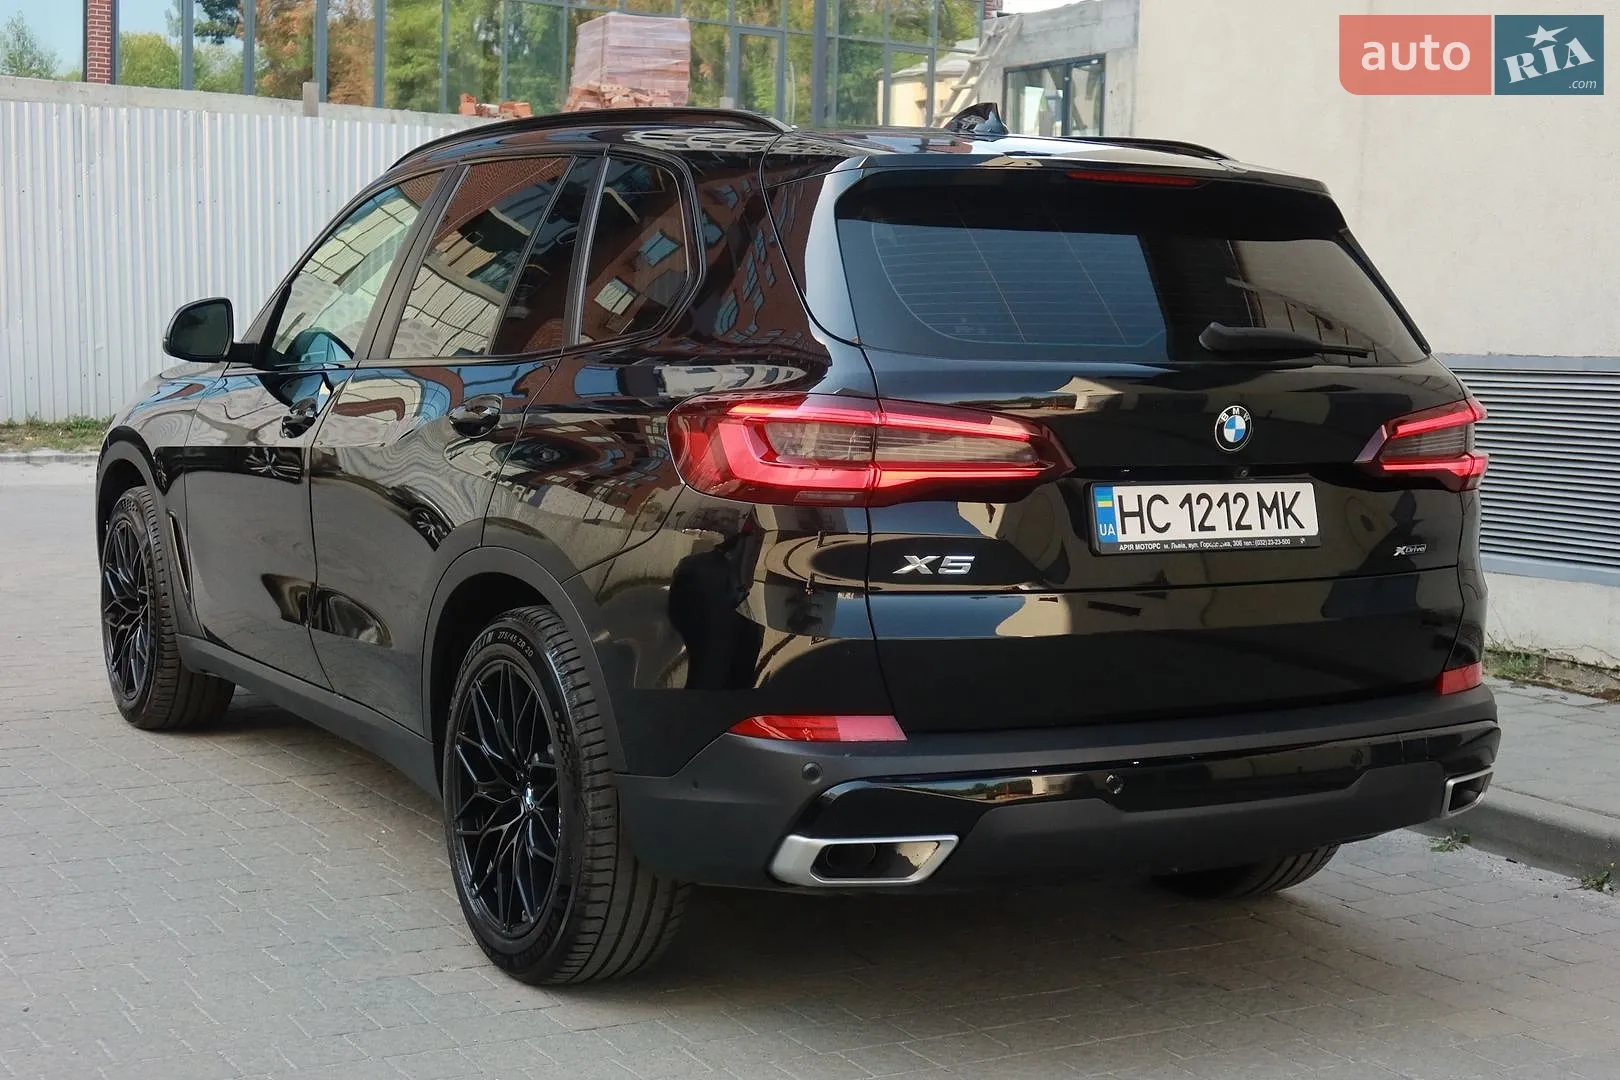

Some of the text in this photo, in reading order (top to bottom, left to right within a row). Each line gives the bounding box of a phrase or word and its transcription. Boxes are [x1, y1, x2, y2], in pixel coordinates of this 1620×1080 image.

[1219, 407, 1251, 422] BMW
[1117, 490, 1305, 535] HC 1212 MK
[1099, 523, 1116, 537] UA
[1134, 542, 1161, 550] МОТОРС
[892, 555, 976, 575] X5
[524, 646, 534, 657] 20
